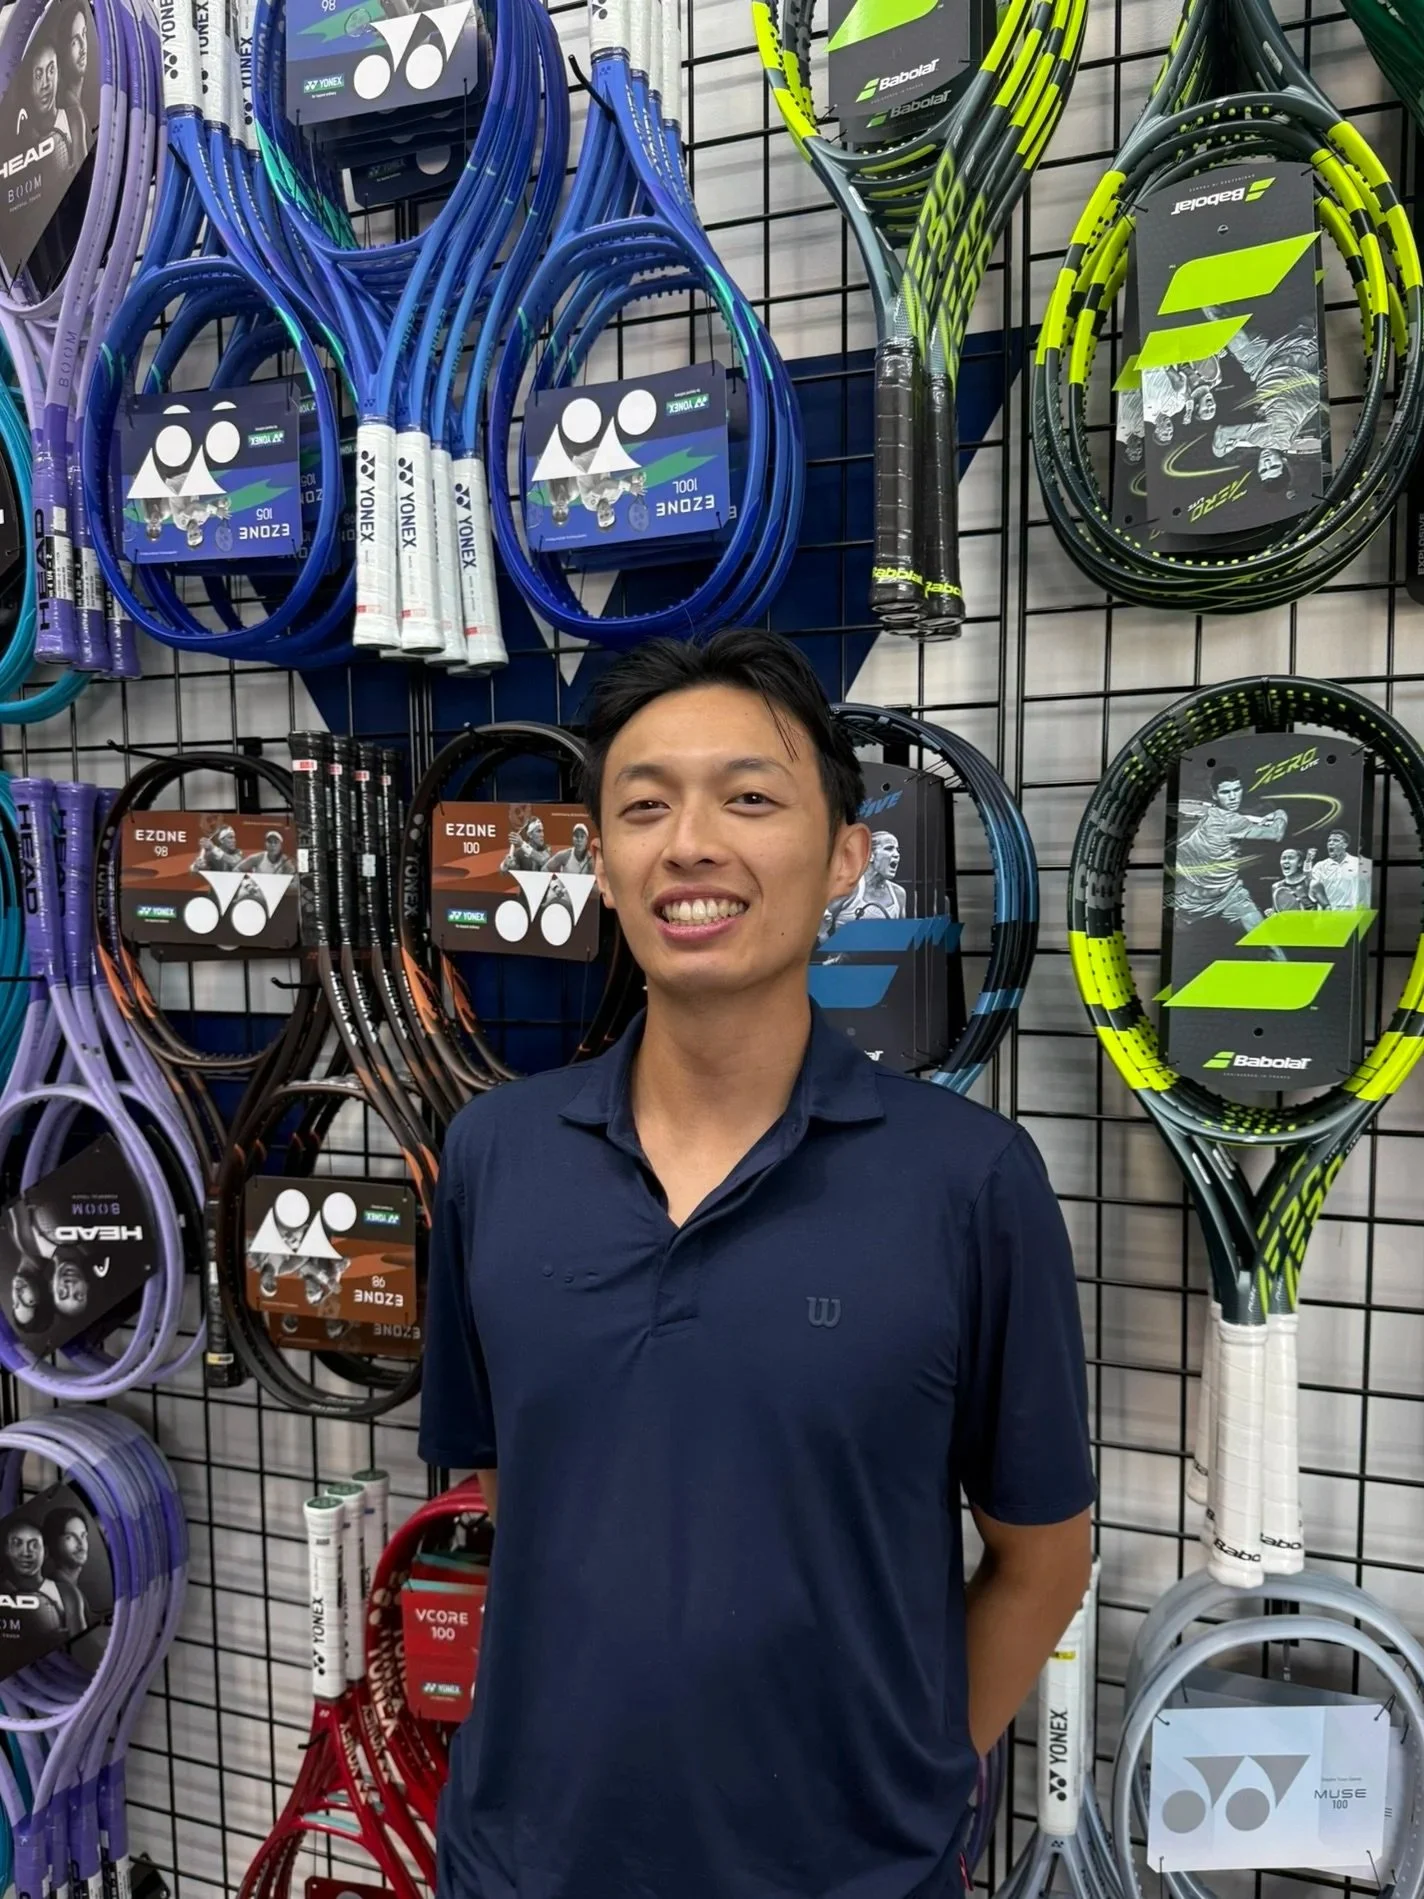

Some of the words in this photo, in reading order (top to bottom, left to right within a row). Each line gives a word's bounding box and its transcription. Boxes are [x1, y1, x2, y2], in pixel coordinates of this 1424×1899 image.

[321, 0, 336, 11] 98
[319, 76, 343, 87] YONEX
[666, 399, 693, 414] YONEX
[250, 435, 272, 445] YONEX
[672, 477, 698, 495] 100L
[655, 494, 715, 517] EZONE
[256, 508, 273, 520] 105
[360, 486, 376, 544] YONEX
[400, 492, 417, 550] YONEX
[238, 523, 291, 540] EZONE
[459, 515, 477, 569] YONEX
[135, 829, 187, 843] EZONE
[445, 823, 497, 838] EZONE
[154, 845, 168, 857] 98
[463, 841, 480, 854] 100
[18, 804, 38, 914] HEAD
[404, 852, 421, 917] YONEX
[152, 907, 175, 918] YONEX
[463, 911, 486, 922] YONEX
[55, 1225, 143, 1241] HEAD
[353, 1289, 404, 1307] EZONE
[373, 1323, 421, 1340] EZONE
[313, 1596, 325, 1645] YONEX
[415, 1608, 469, 1626] VCORE
[431, 1627, 455, 1642] 100
[437, 1683, 461, 1695] YONEX
[1050, 1709, 1068, 1765] YONEX
[1314, 1788, 1367, 1799] MUSE
[1332, 1799, 1348, 1809] 100
